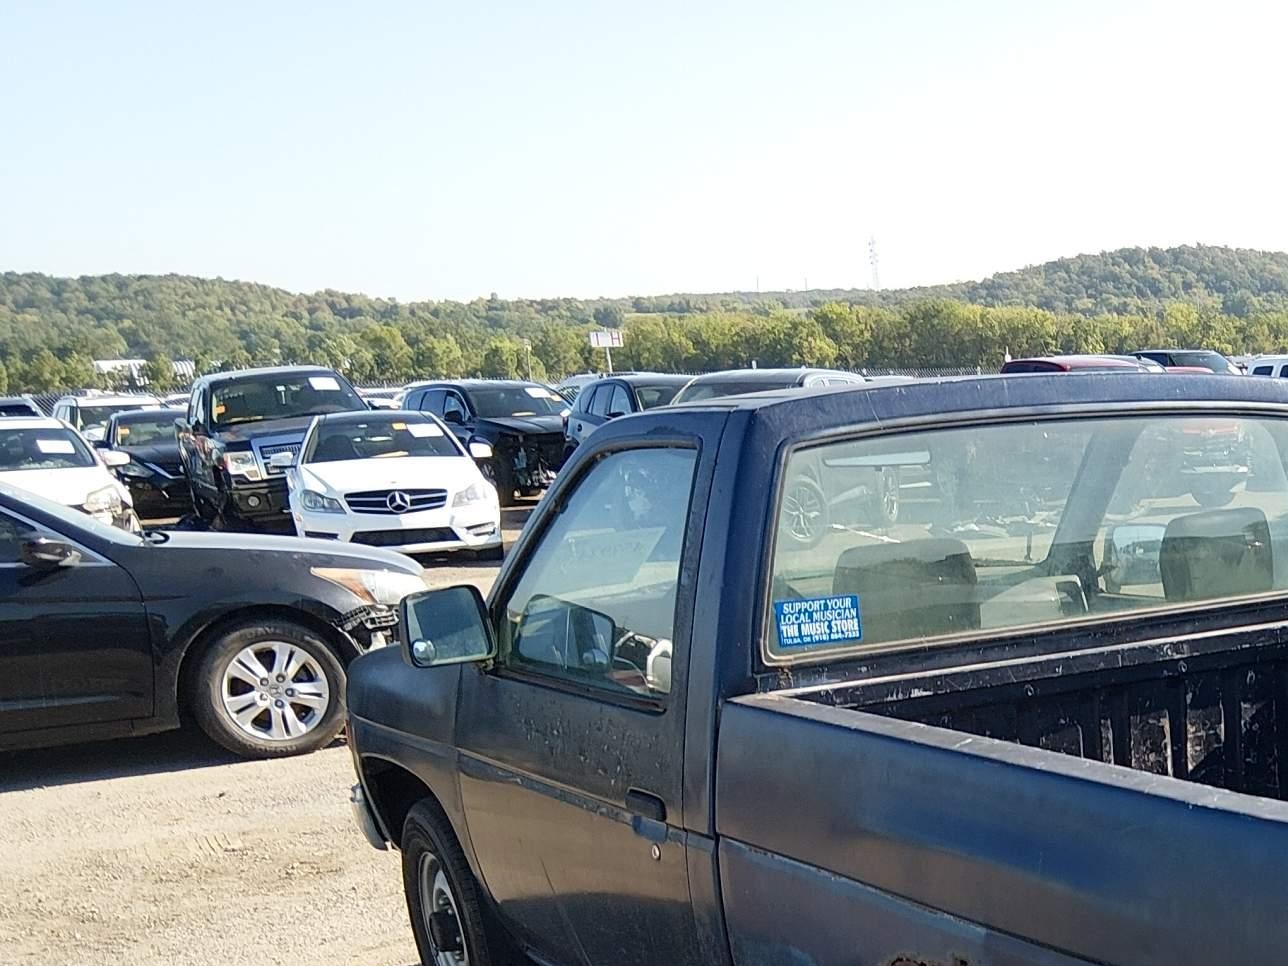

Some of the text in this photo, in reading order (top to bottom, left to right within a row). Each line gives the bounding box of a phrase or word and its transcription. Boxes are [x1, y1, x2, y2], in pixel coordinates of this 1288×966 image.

[783, 598, 852, 614] SUPPORT YOUR
[781, 608, 857, 625] LOCAL MUSICIAN
[781, 617, 859, 638] THE MUSIC STORE
